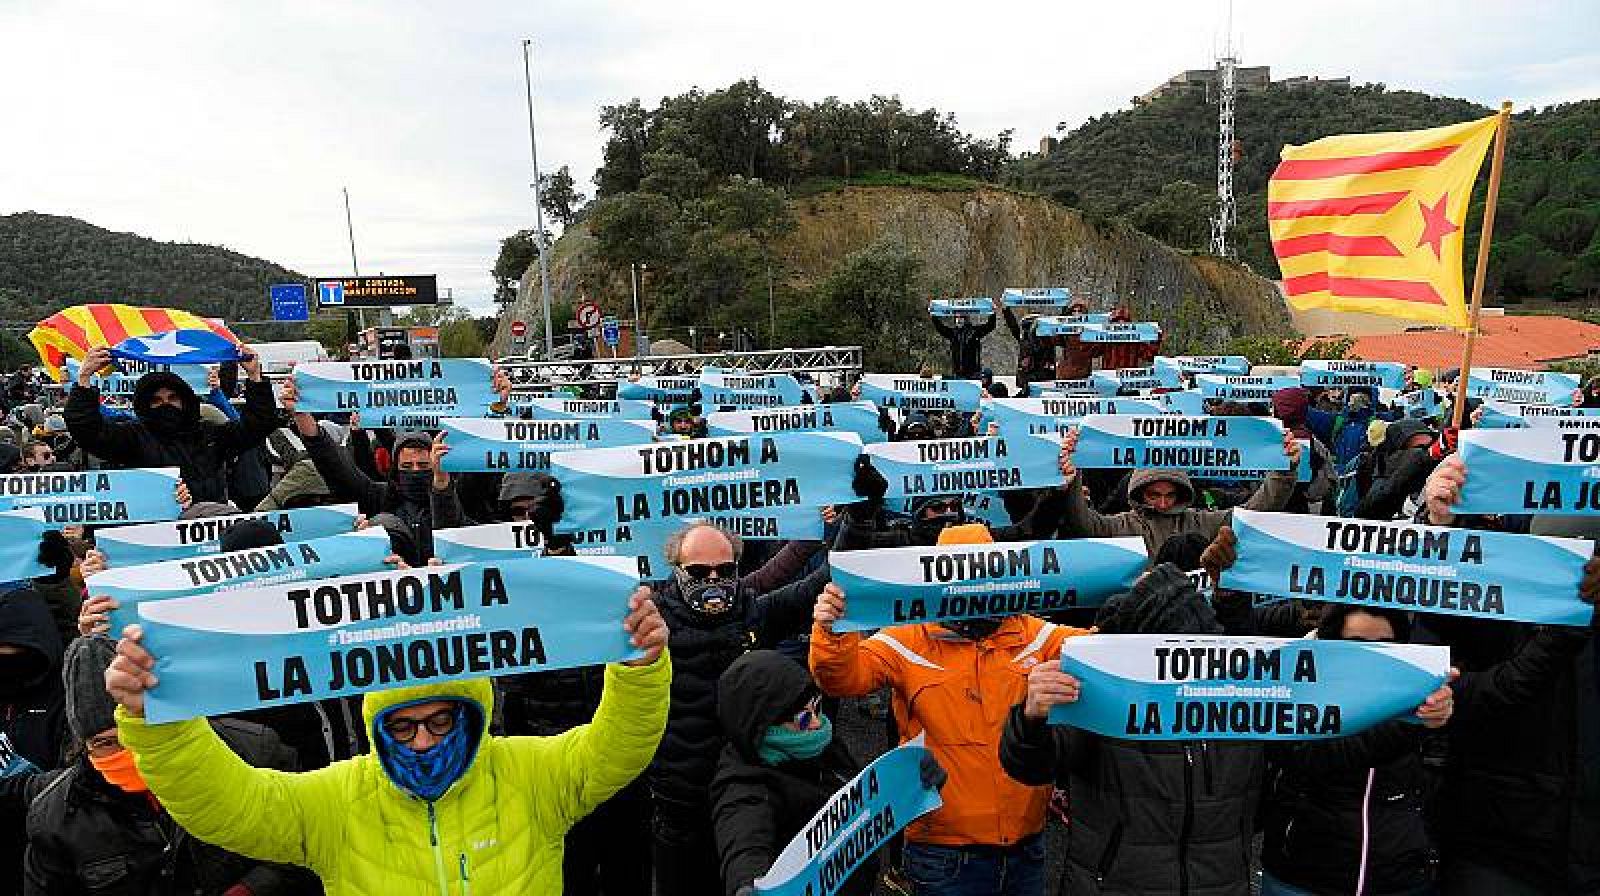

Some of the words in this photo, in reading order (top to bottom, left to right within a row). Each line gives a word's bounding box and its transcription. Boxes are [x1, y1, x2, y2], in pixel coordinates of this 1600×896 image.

[351, 361, 425, 381] TOTHOM
[429, 361, 443, 379] A
[722, 377, 765, 389] TOTHOM
[893, 379, 937, 392] TOTHOM
[336, 391, 361, 409] LA
[366, 387, 459, 409] JONQUERA
[564, 401, 609, 413] TOTHOM
[1041, 400, 1101, 417] TOTHOM
[1107, 401, 1117, 415] A
[382, 416, 397, 427] LA
[503, 422, 580, 441] TOTHOM
[587, 423, 600, 441] A
[751, 411, 816, 433] TOTHOM
[822, 410, 835, 428] A
[1131, 418, 1209, 438] TOTHOM
[1214, 418, 1229, 437] A
[486, 451, 511, 470] LA
[639, 439, 751, 475] TOTHOM
[759, 437, 779, 464] A
[917, 440, 989, 463] TOTHOM
[994, 440, 1008, 457] A
[1112, 448, 1137, 465] LA
[1143, 447, 1242, 467] JONQUERA
[96, 473, 111, 492] A
[903, 474, 927, 495] LA
[931, 467, 1023, 491] JONQUERA
[615, 493, 651, 522] LA
[661, 477, 801, 517] JONQUERA
[1523, 480, 1563, 509] LA
[277, 513, 292, 534] A
[1325, 521, 1449, 561] TOTHOM
[1459, 535, 1484, 565] A
[182, 548, 296, 587] TOTHOM
[299, 543, 321, 565] A
[919, 548, 1031, 583] TOTHOM
[1041, 547, 1061, 575] A
[287, 570, 465, 629] TOTHOM
[480, 567, 509, 607] A
[1289, 565, 1325, 596] LA
[1335, 569, 1506, 615] JONQUERA
[892, 598, 927, 622] LA
[937, 587, 1080, 618] JONQUERA
[254, 655, 313, 701] LA
[328, 626, 547, 692] JONQUERA
[1154, 647, 1281, 682] TOTHOM
[1293, 649, 1317, 683] A
[1126, 702, 1163, 735] LA
[1170, 701, 1342, 735] JONQUERA
[805, 778, 863, 860] TOTHOM
[868, 767, 879, 801] A
